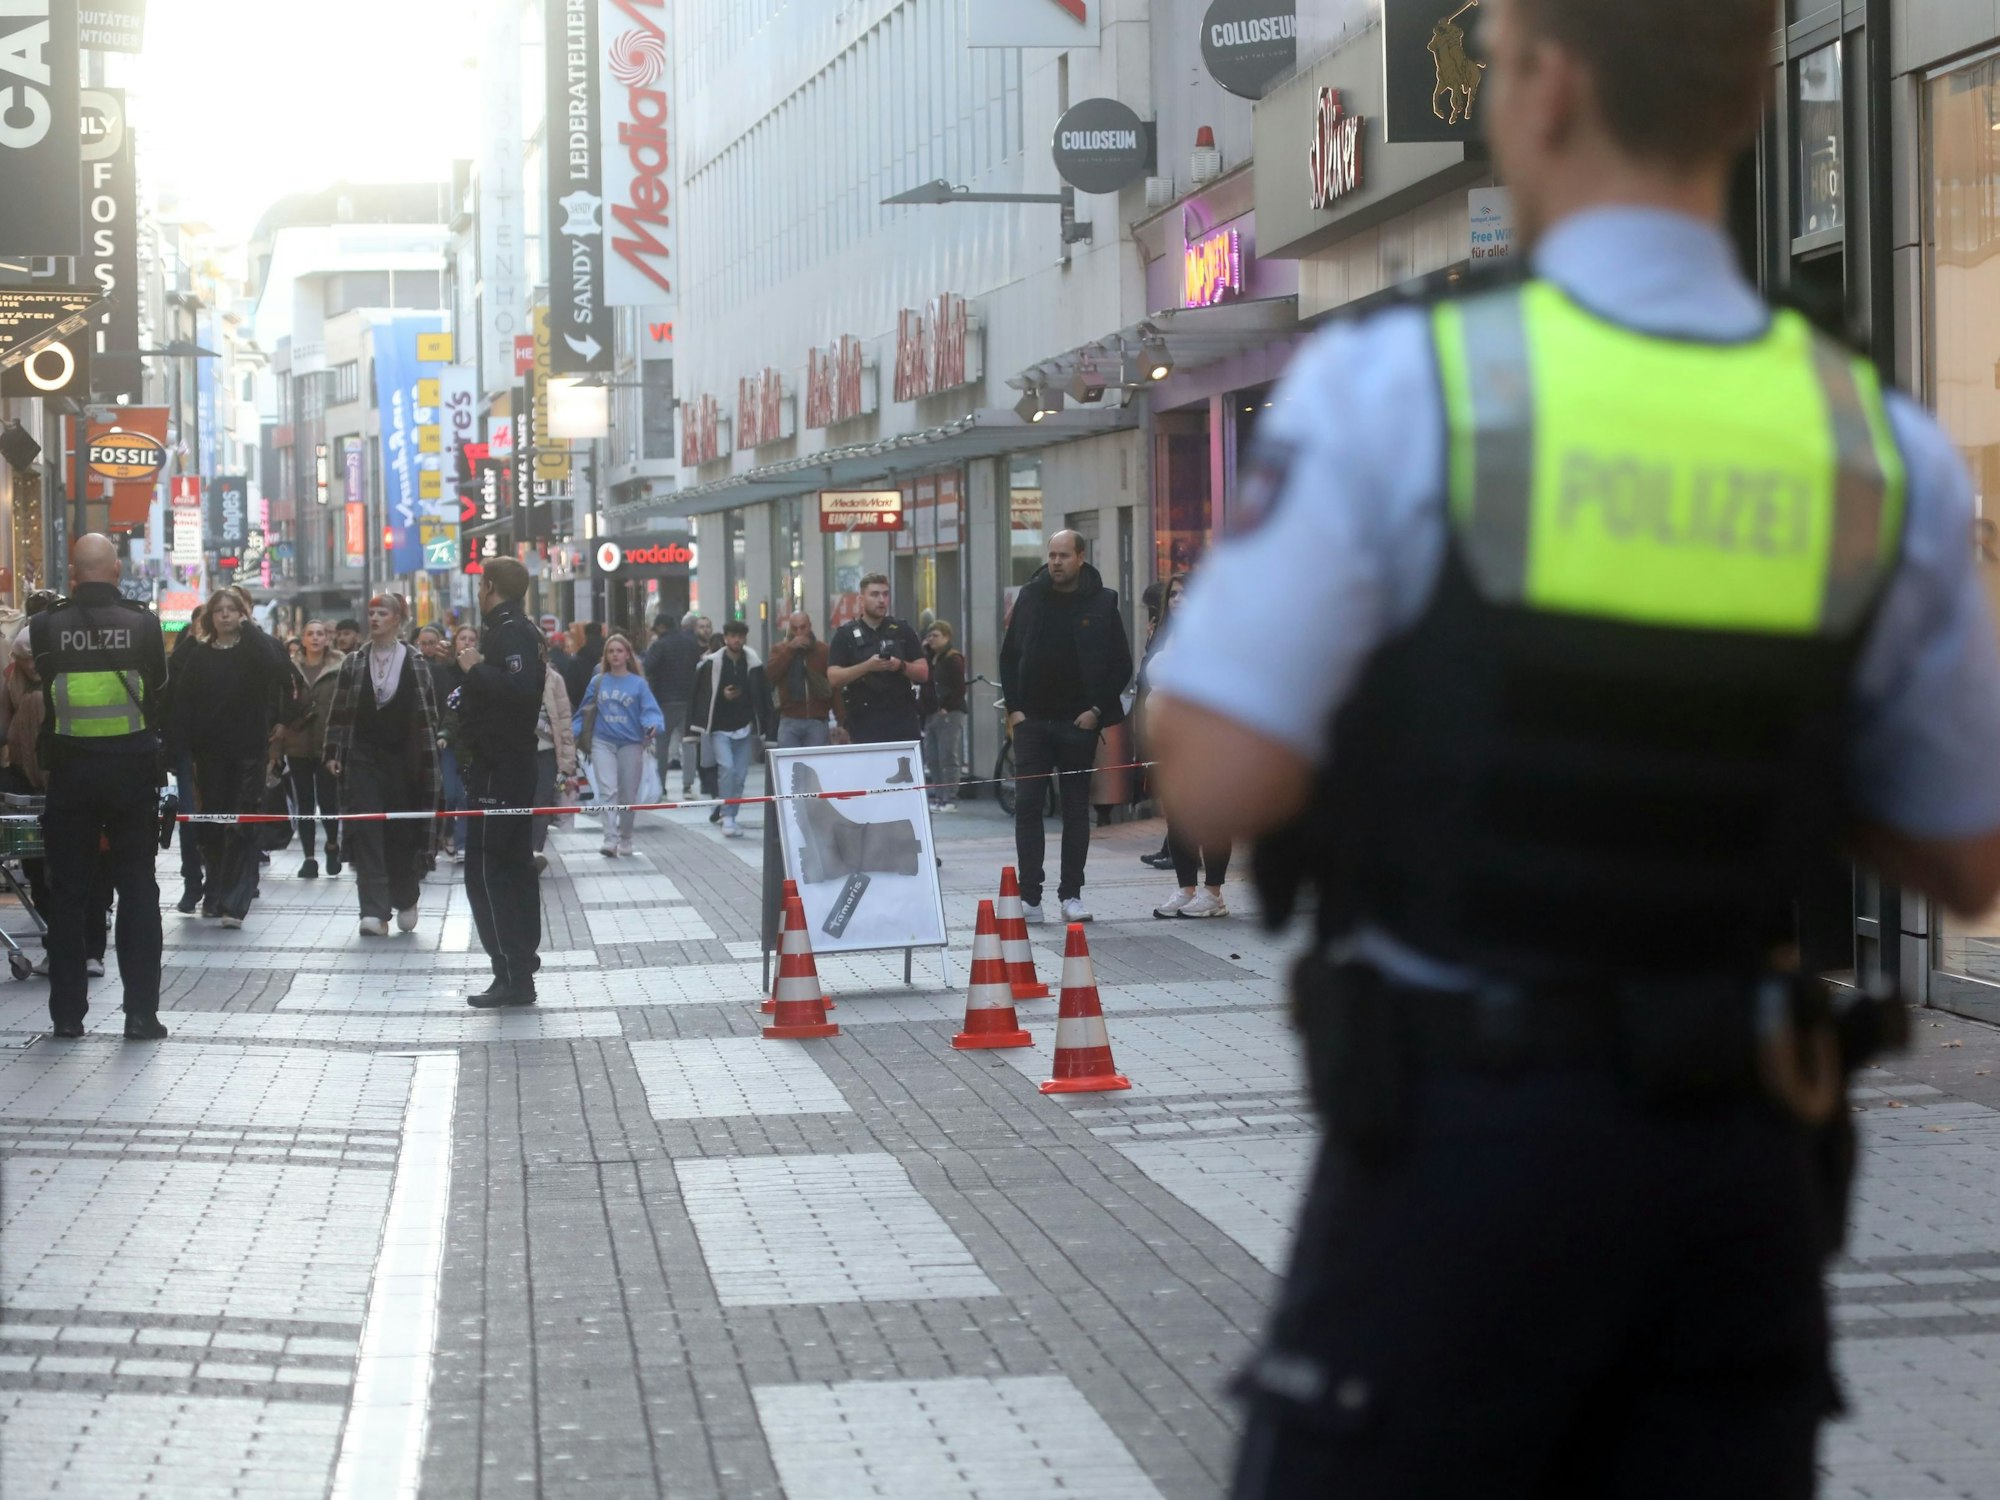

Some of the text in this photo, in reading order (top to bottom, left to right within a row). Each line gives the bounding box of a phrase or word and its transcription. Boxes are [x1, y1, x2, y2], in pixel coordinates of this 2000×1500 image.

[0, 0, 51, 148] CA
[567, 0, 590, 180] LEDERATELIER
[1061, 130, 1137, 150] COLLOSEUM
[1471, 231, 1492, 243] Free
[1472, 244, 1508, 259] für alle!
[573, 240, 592, 324] SANDY
[0, 294, 92, 303] NKARTIKEL
[89, 447, 159, 465] FOSSIL
[1558, 450, 1808, 558] POLIZEI
[60, 629, 131, 651] POLIZEI
[828, 879, 863, 930] tamaris
